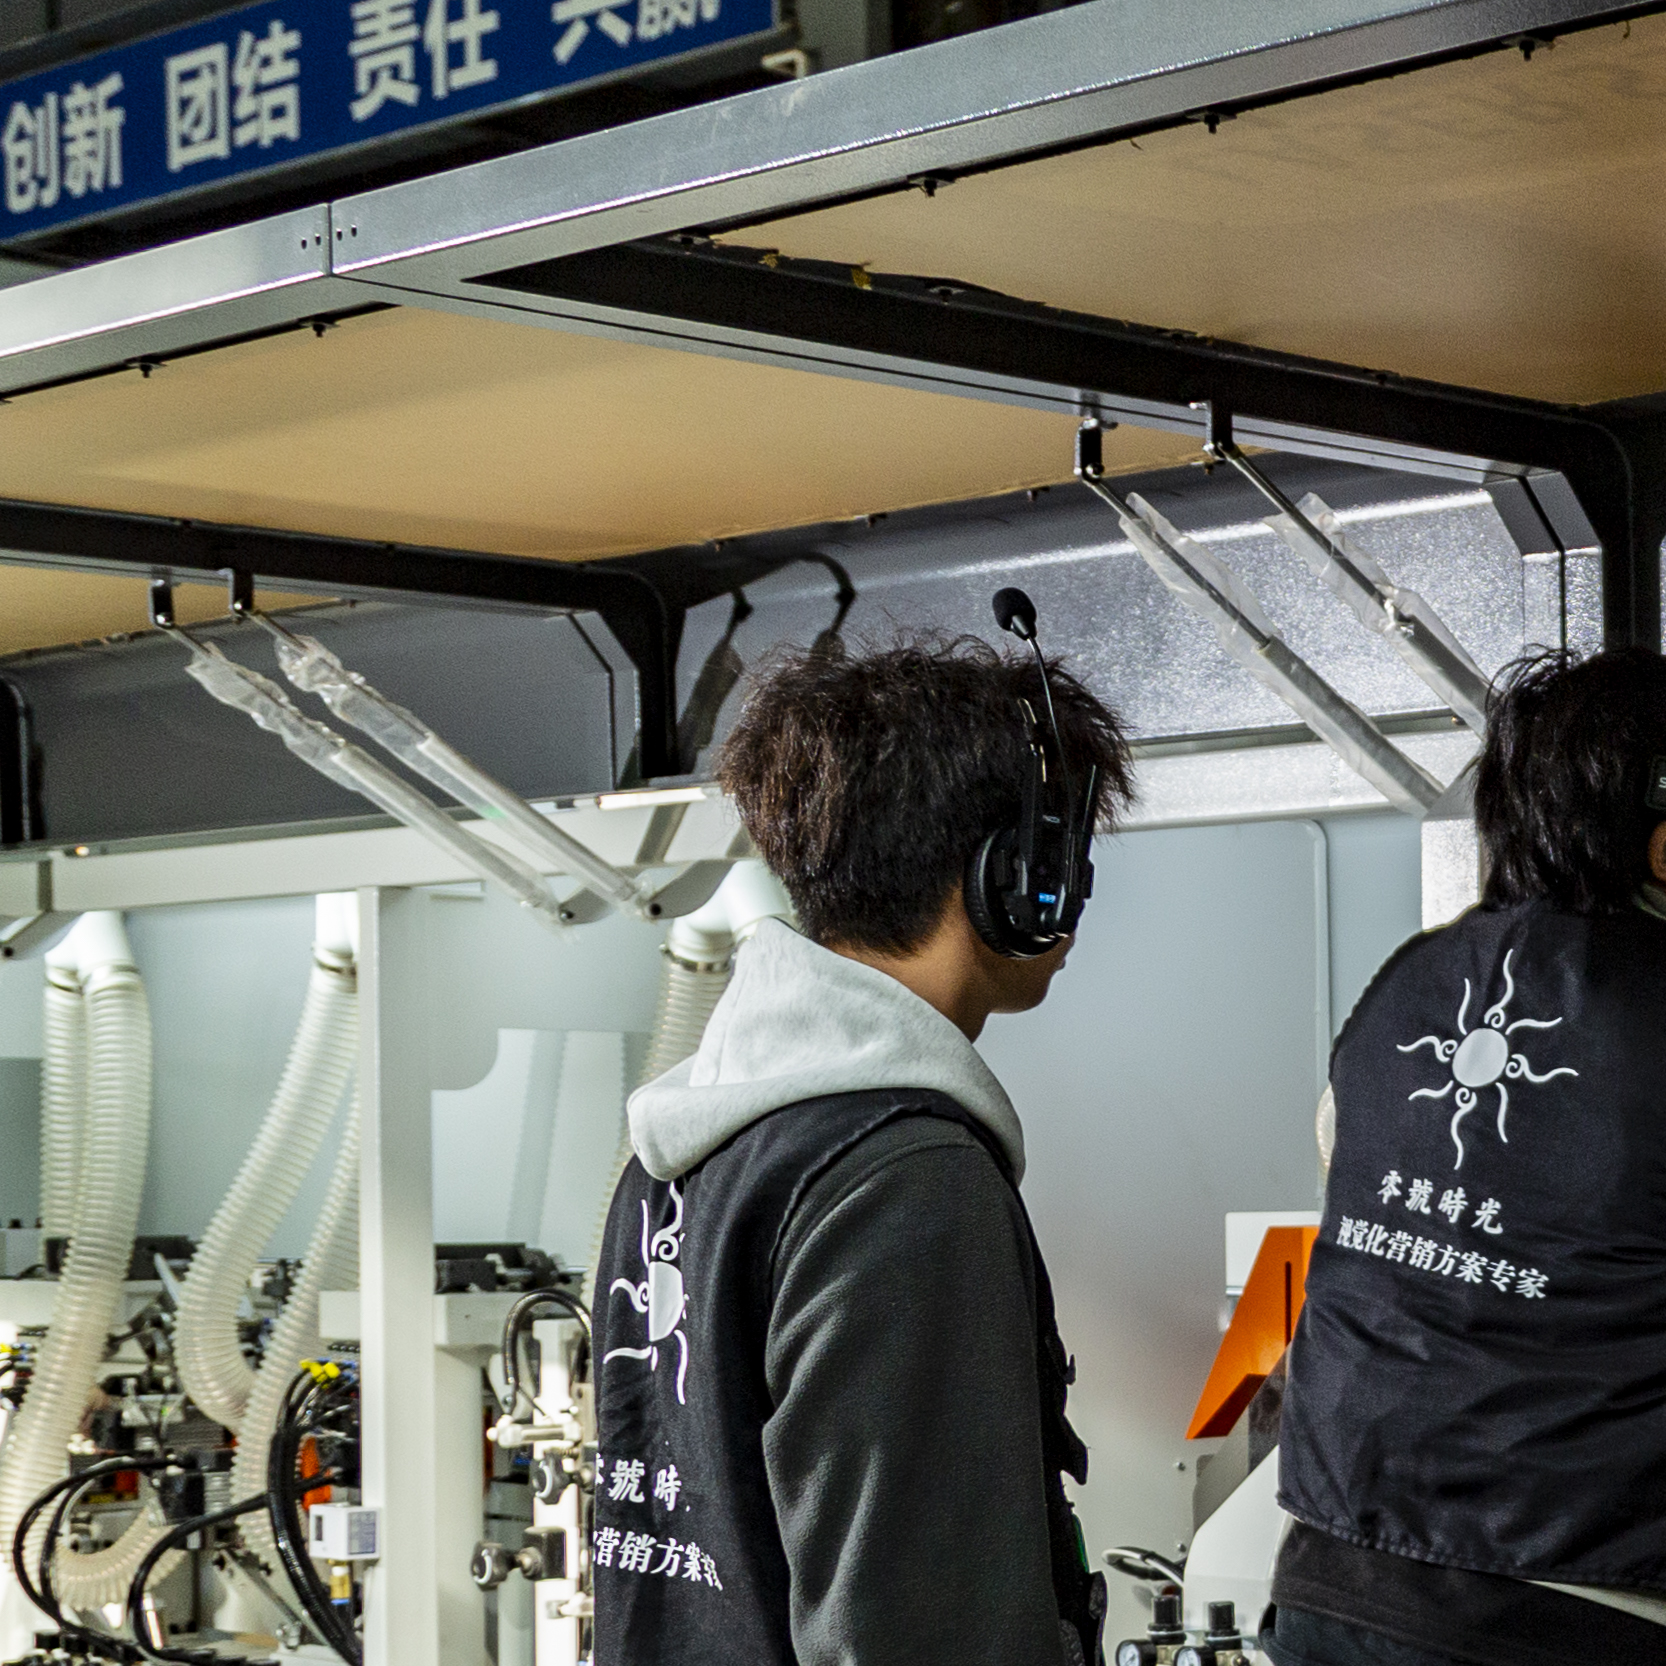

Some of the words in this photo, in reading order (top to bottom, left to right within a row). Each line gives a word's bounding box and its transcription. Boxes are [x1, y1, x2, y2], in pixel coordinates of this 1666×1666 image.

[4, 72, 125, 214] 创新
[165, 19, 302, 173] 团结
[347, 0, 500, 122] 责任
[1377, 1169, 1504, 1235] 零號時光
[1336, 1214, 1550, 1299] 视觉化营销方案专家
